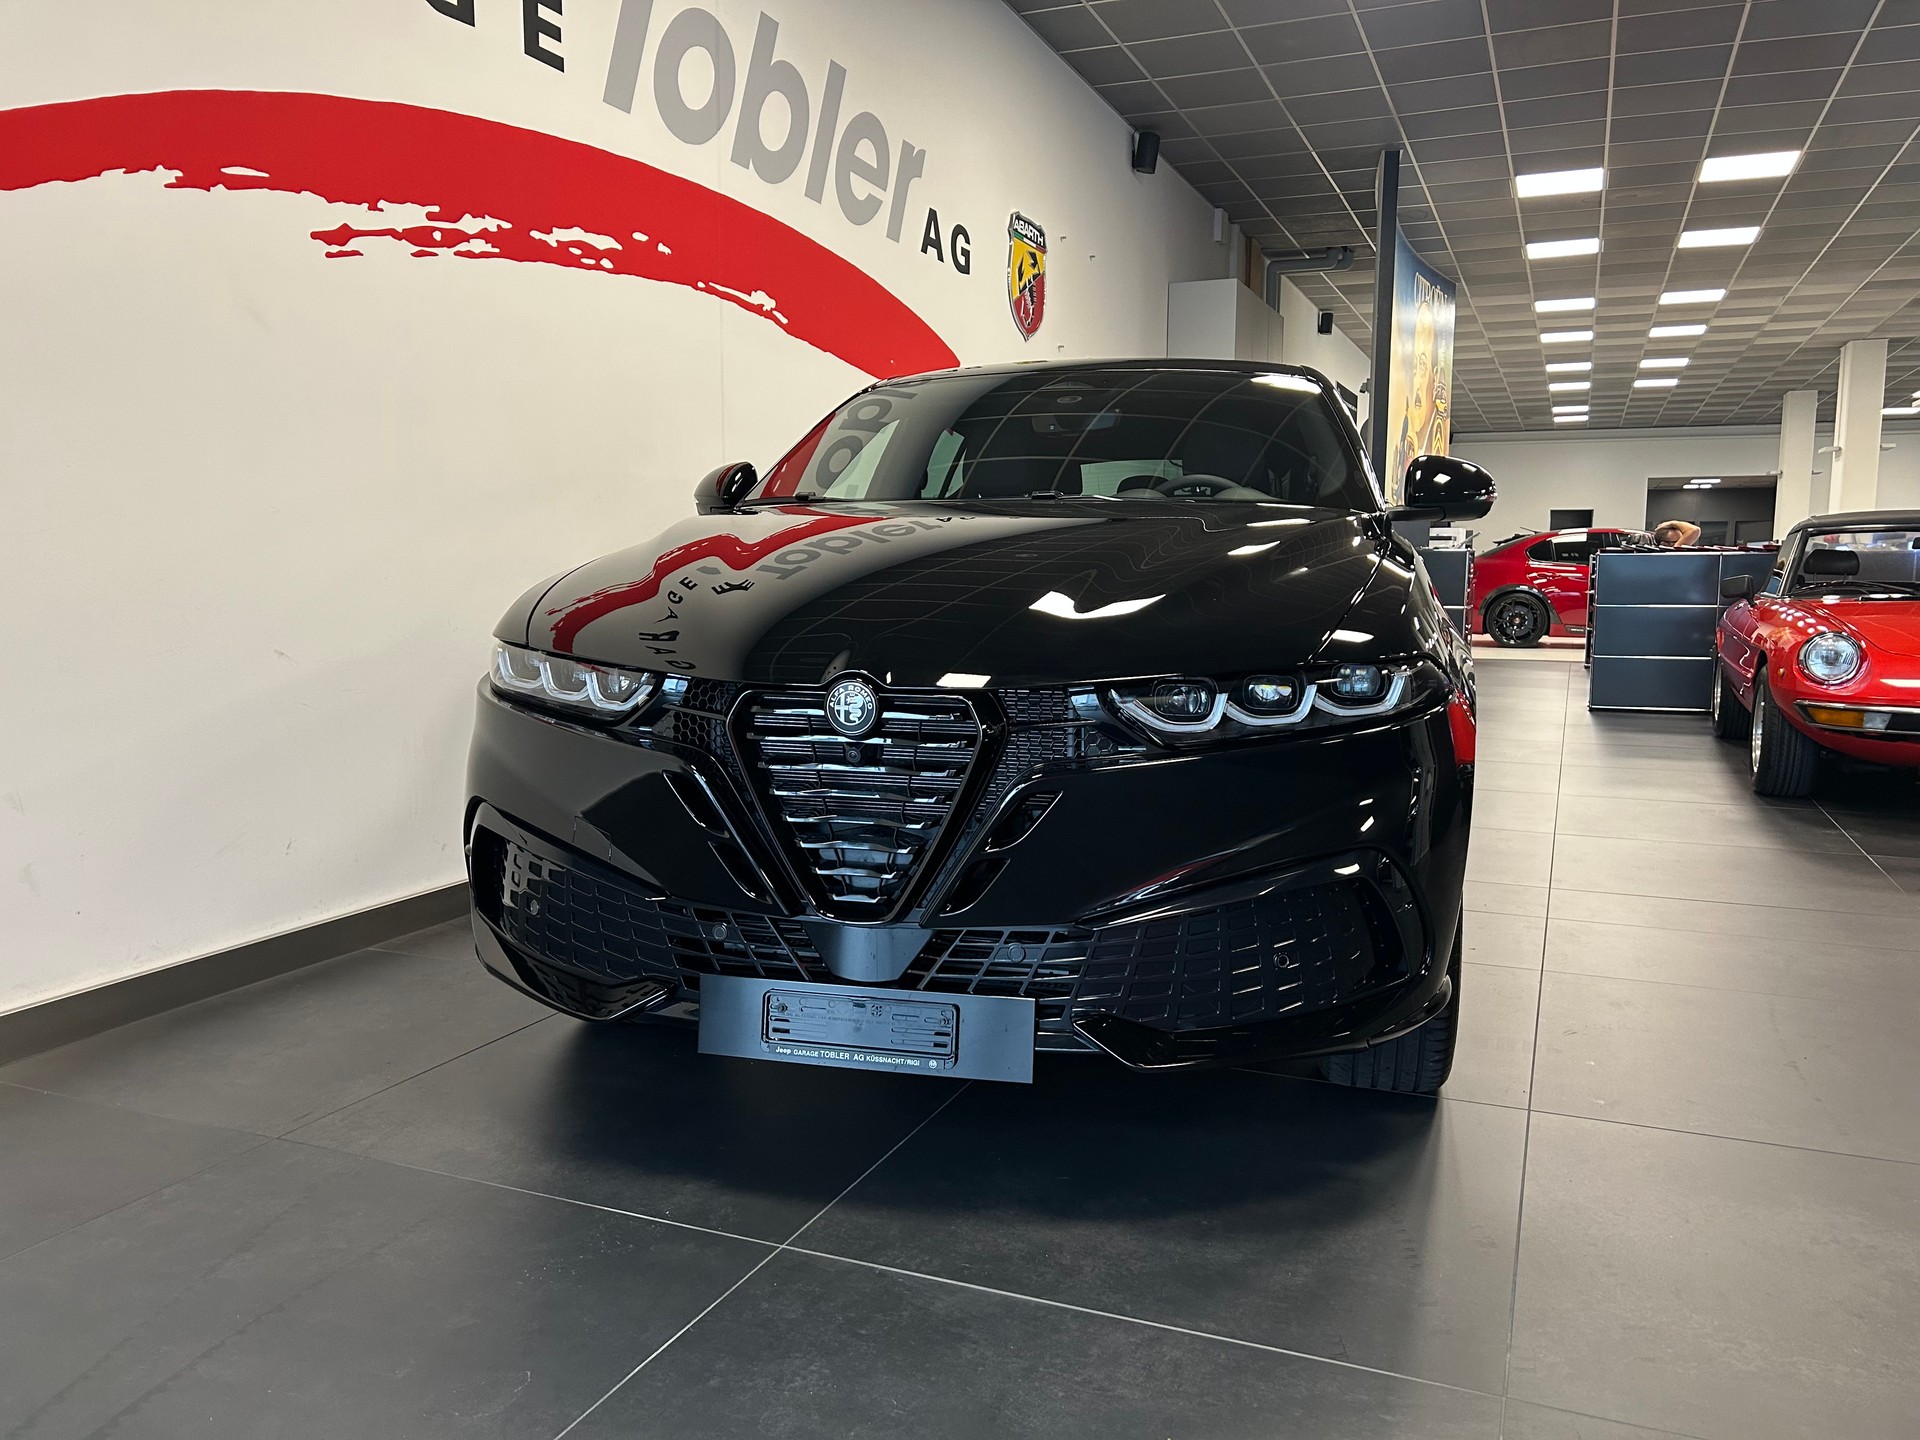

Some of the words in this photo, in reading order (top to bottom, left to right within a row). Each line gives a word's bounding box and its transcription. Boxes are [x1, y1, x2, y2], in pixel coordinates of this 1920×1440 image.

[920, 208, 971, 275] AG
[1013, 218, 1044, 247] ABARTH
[1414, 271, 1448, 308] CITROËN
[830, 687, 845, 708] ALFA
[848, 685, 873, 710] ROMEO
[775, 1046, 791, 1055] Jeep
[793, 1049, 819, 1058] GARAGE
[820, 1050, 850, 1060] TOBLER
[853, 1053, 865, 1062] AG
[866, 1054, 920, 1067] KÜSSNACHT/RIGI
